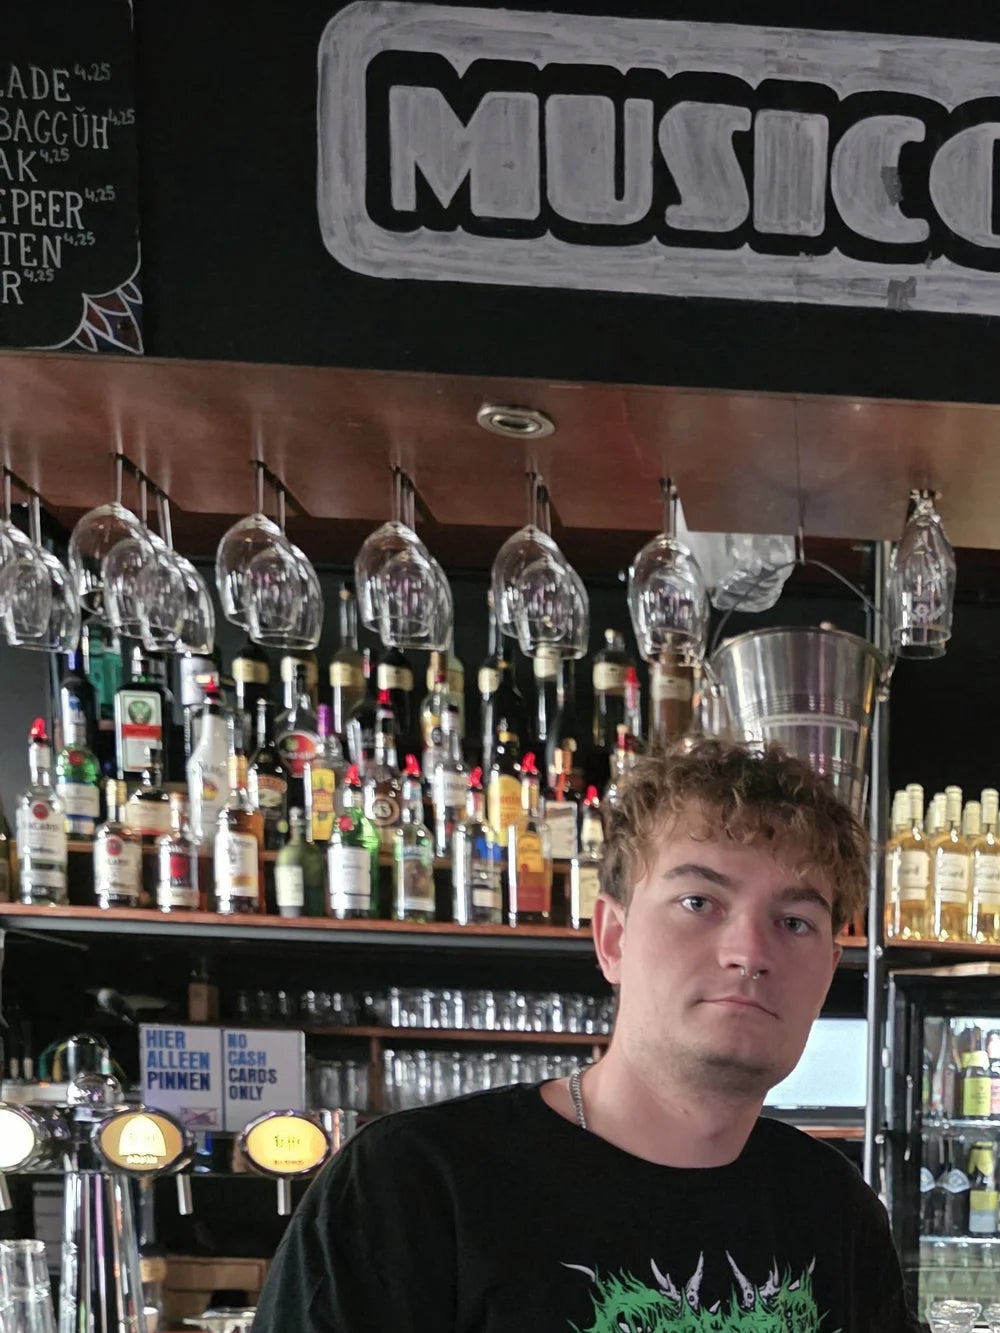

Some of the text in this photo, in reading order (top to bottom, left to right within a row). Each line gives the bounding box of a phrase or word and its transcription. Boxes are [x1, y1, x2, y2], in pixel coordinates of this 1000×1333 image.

[145, 1030, 186, 1049] HIER
[227, 1033, 248, 1049] NO
[146, 1050, 211, 1070] ALLEEN
[227, 1050, 267, 1067] CASH
[147, 1071, 211, 1091] PINNEN
[228, 1068, 278, 1084] CARDS
[229, 1086, 264, 1101] ONLY
